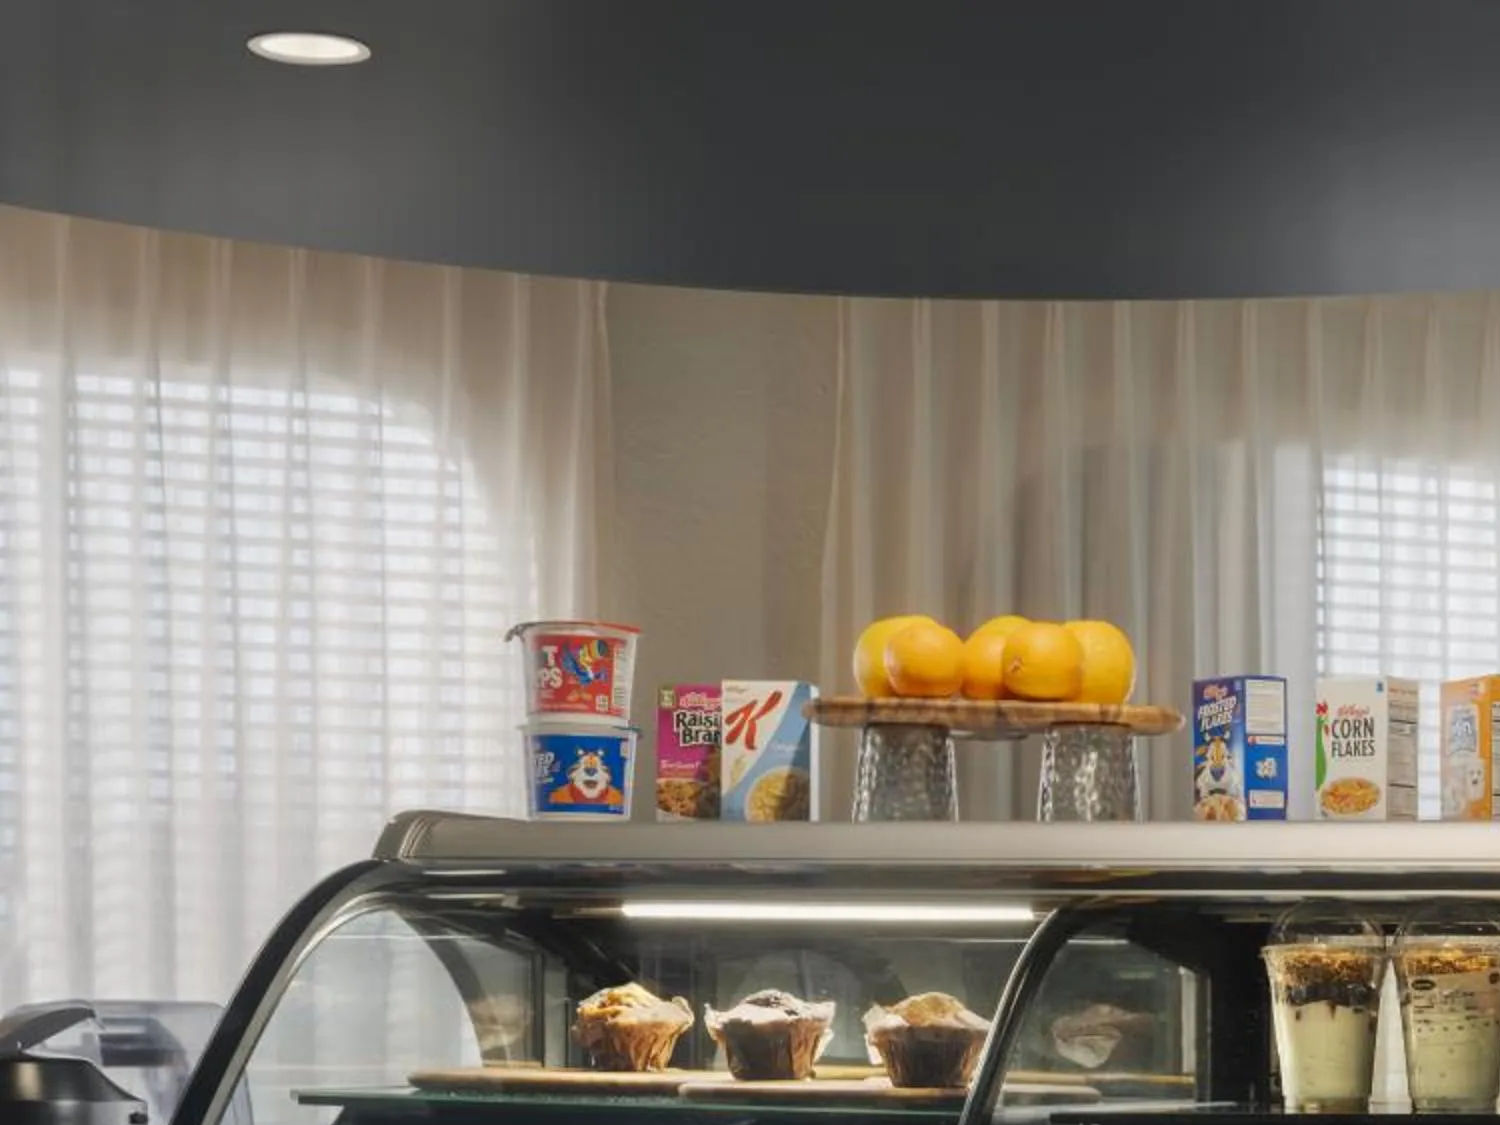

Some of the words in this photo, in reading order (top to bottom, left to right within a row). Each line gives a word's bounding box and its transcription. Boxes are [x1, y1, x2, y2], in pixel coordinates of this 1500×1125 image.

[675, 710, 720, 728] Raisi
[1331, 717, 1375, 739] CORN
[1331, 740, 1376, 757] FLAKES
